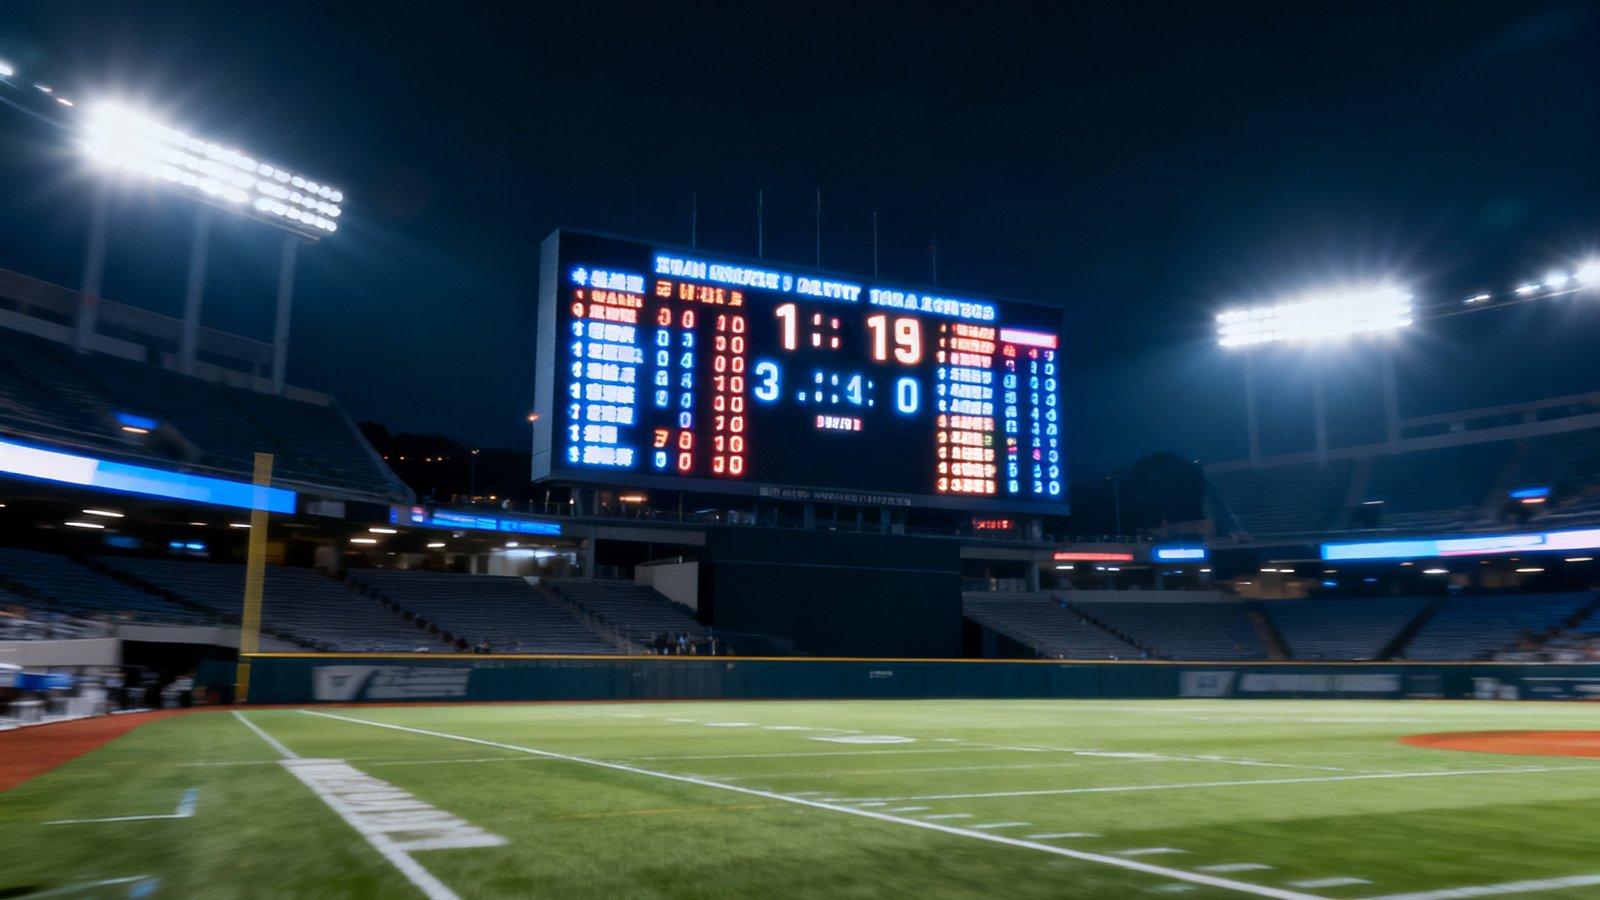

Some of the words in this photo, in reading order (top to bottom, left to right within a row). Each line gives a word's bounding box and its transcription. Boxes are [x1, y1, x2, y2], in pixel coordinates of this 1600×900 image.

[775, 303, 796, 351] 1
[867, 314, 921, 364] 19
[754, 361, 780, 402] 3
[896, 377, 919, 414] 0
